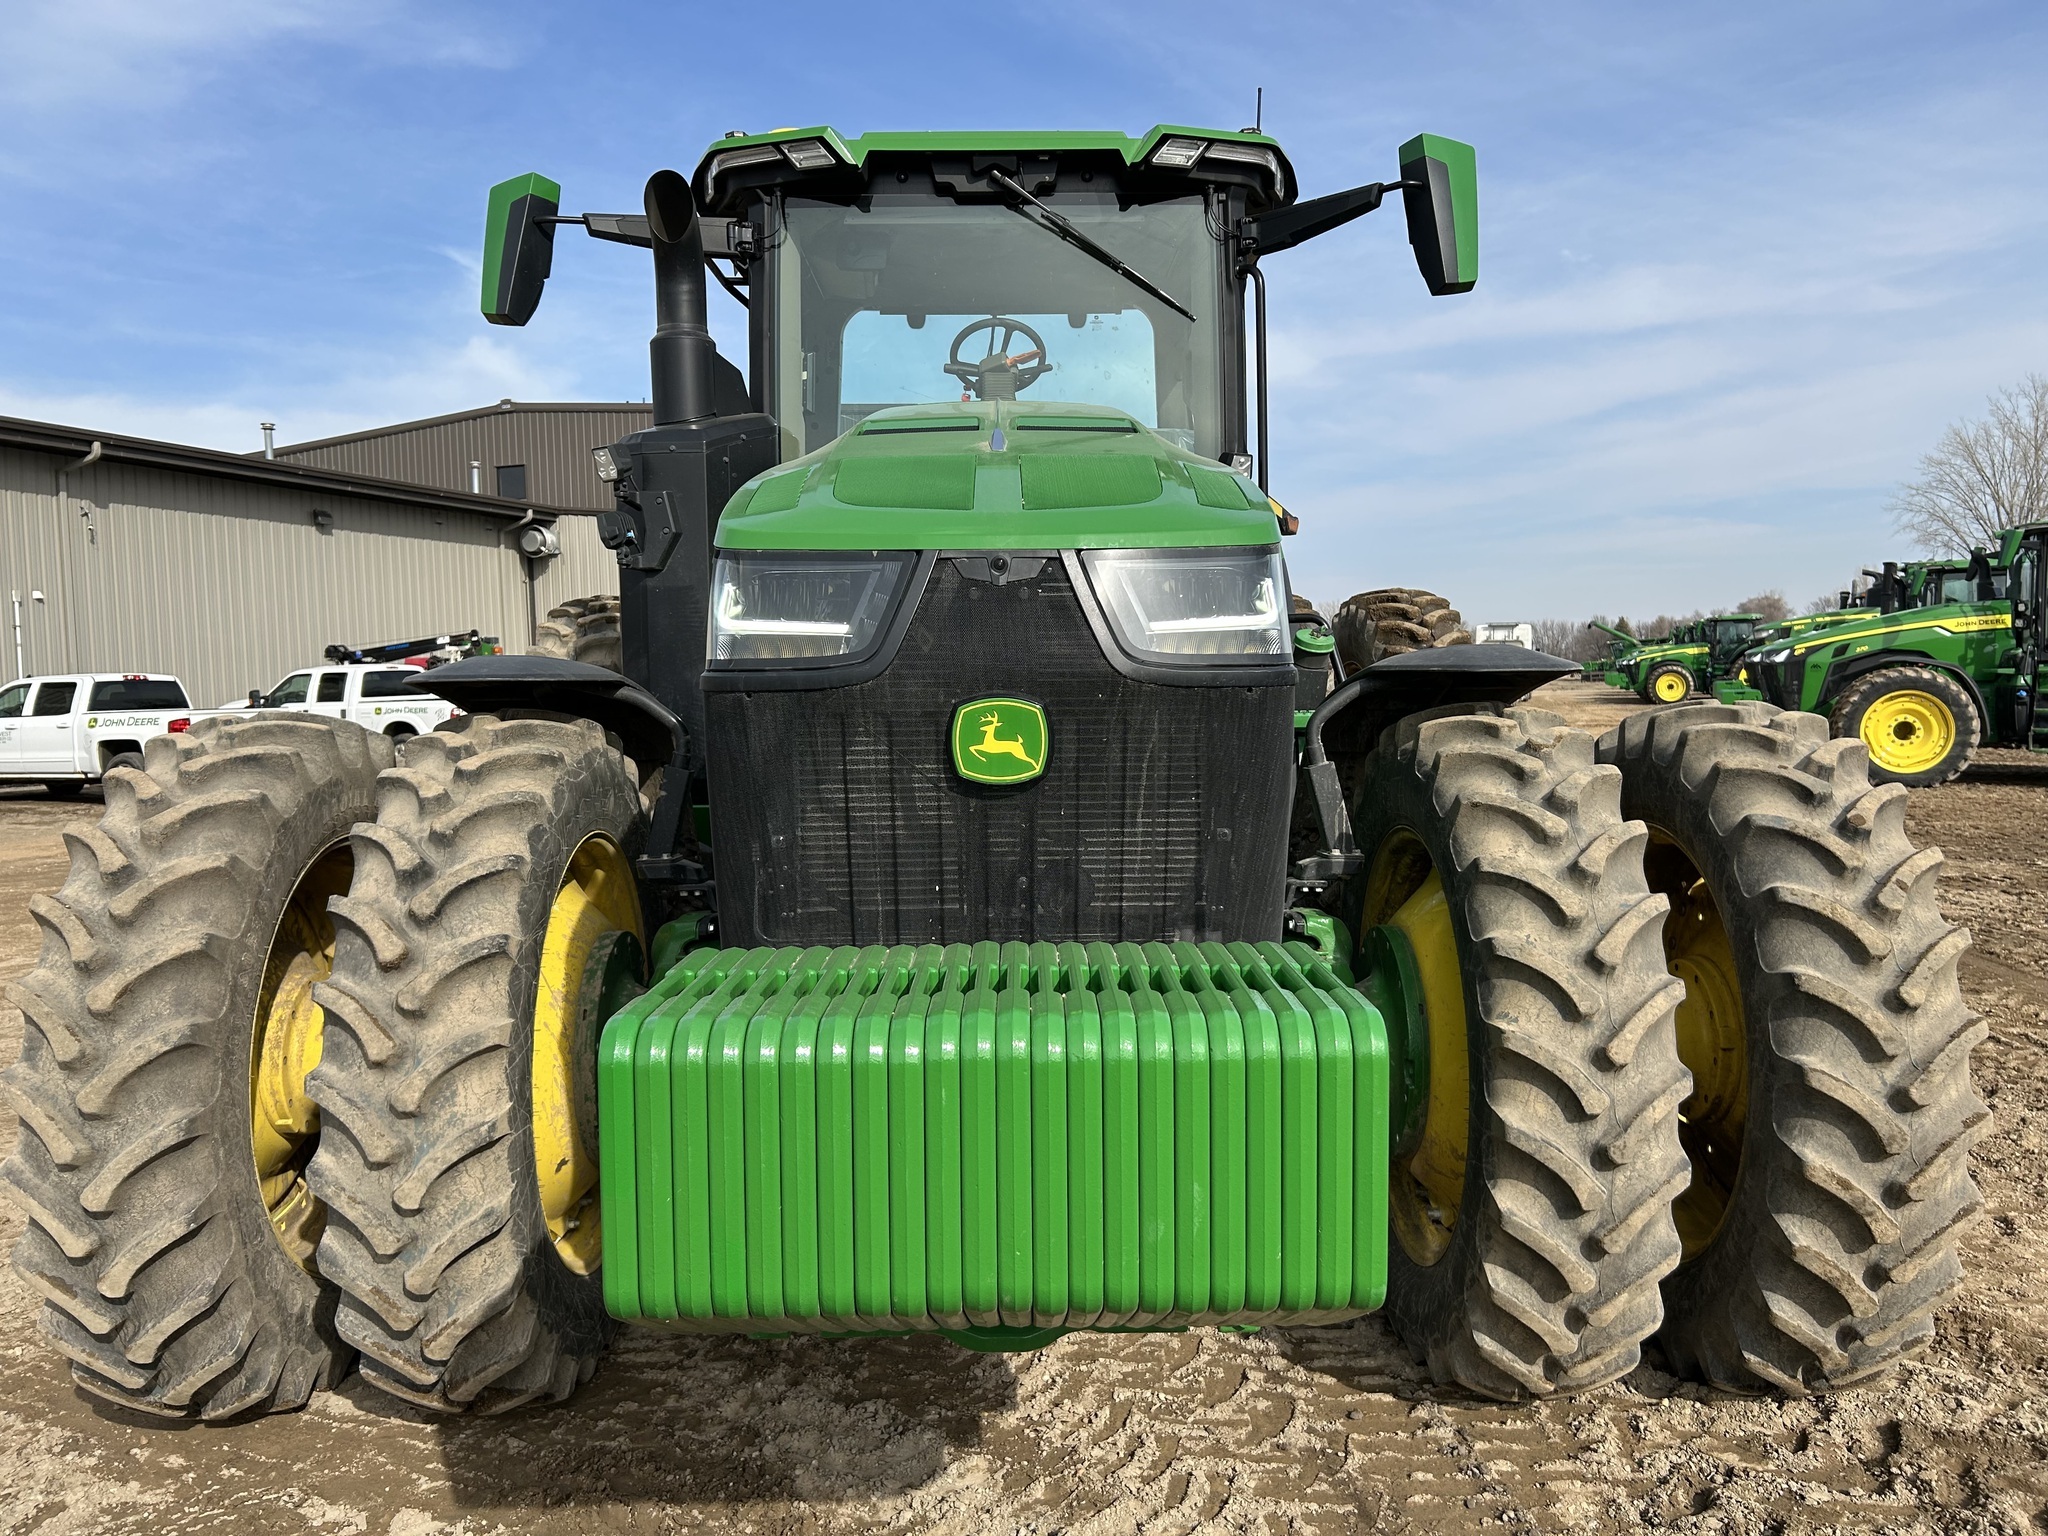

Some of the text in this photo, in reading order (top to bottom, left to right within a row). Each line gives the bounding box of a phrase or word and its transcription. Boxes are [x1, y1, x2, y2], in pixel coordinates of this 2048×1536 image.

[1955, 620, 1977, 628] JOHN
[384, 706, 428, 715] JOHN DEERE
[98, 716, 160, 727] JOHN DEERE
